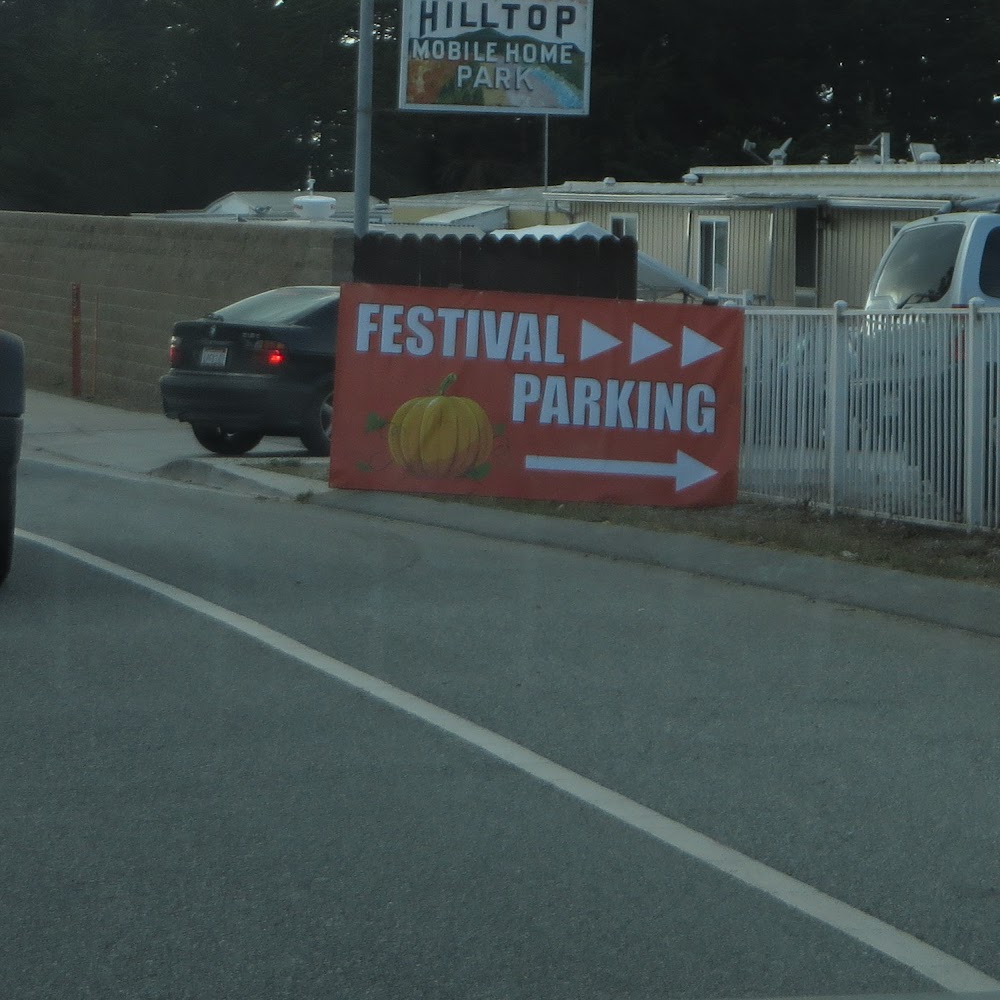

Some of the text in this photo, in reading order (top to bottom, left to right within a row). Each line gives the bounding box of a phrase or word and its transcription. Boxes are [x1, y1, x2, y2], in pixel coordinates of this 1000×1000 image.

[420, 0, 576, 38] HILLTOP
[412, 39, 574, 65] MOBILE HOME
[457, 66, 534, 90] PARK
[356, 303, 564, 364] FESTIVAL
[512, 373, 716, 435] PARKING
